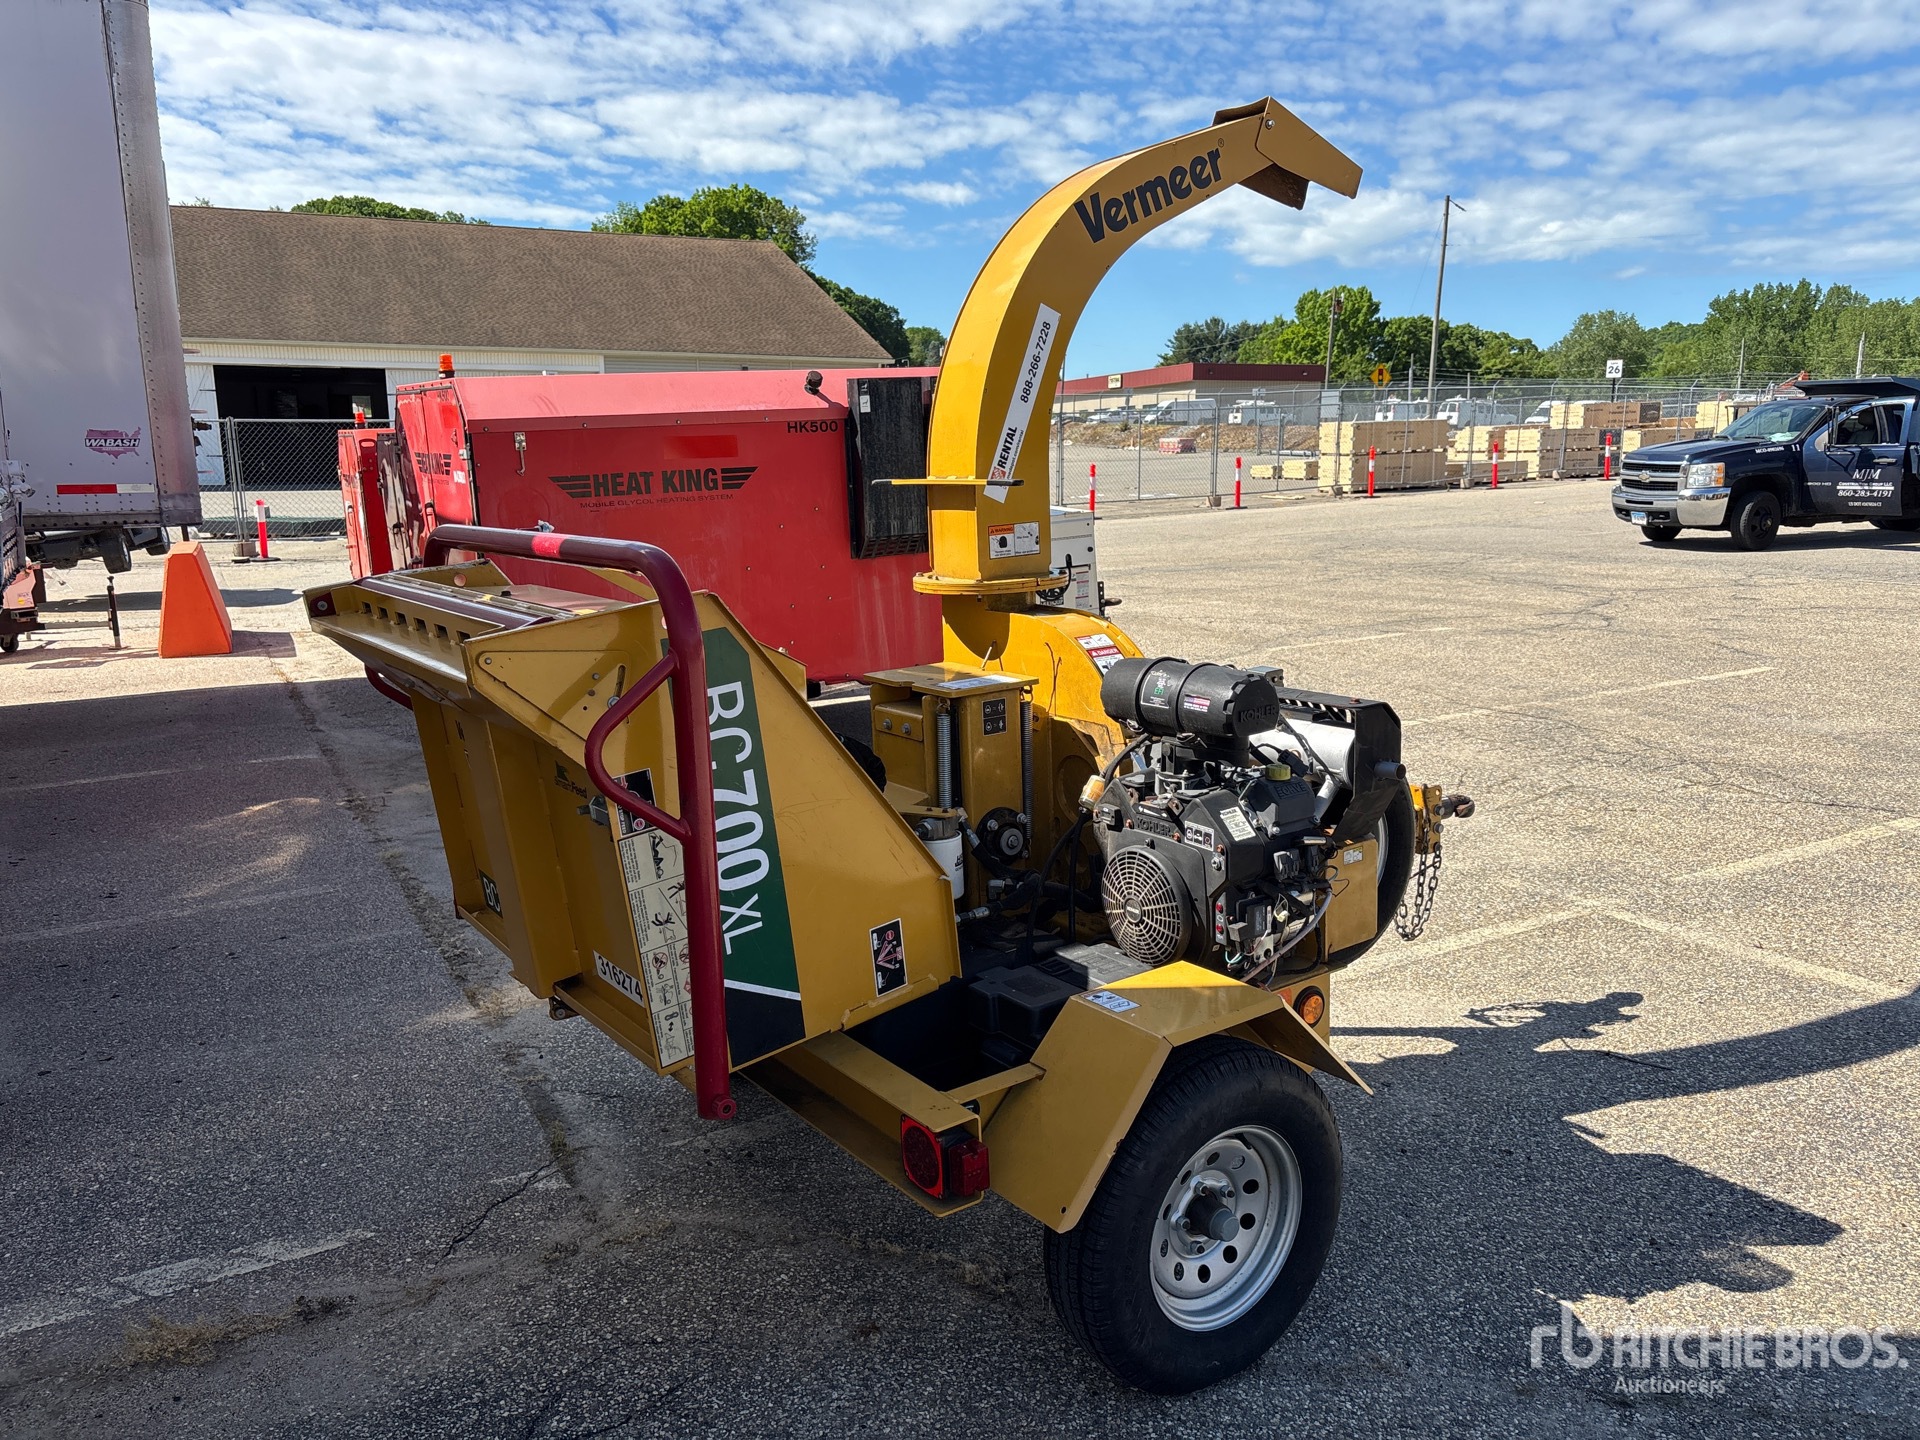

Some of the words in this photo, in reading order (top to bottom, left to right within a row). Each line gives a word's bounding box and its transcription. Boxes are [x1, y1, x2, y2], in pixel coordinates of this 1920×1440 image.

[1073, 148, 1222, 244] Vermeer
[1020, 321, 1051, 404] 888-266-7228
[1608, 365, 1621, 374] 26
[787, 420, 838, 433] HK500
[85, 438, 139, 447] WABASH
[997, 427, 1018, 469] RENTAL
[592, 471, 654, 497] HEAT
[662, 468, 718, 493] KING
[1852, 469, 1881, 481] MJM
[580, 501, 615, 509] MOBILE
[656, 496, 696, 504] HEATING
[1837, 489, 1892, 498] 860-283-4191
[1238, 703, 1277, 722] KOHLER
[1137, 817, 1171, 837] KOHLER
[598, 955, 643, 1002] 316274
